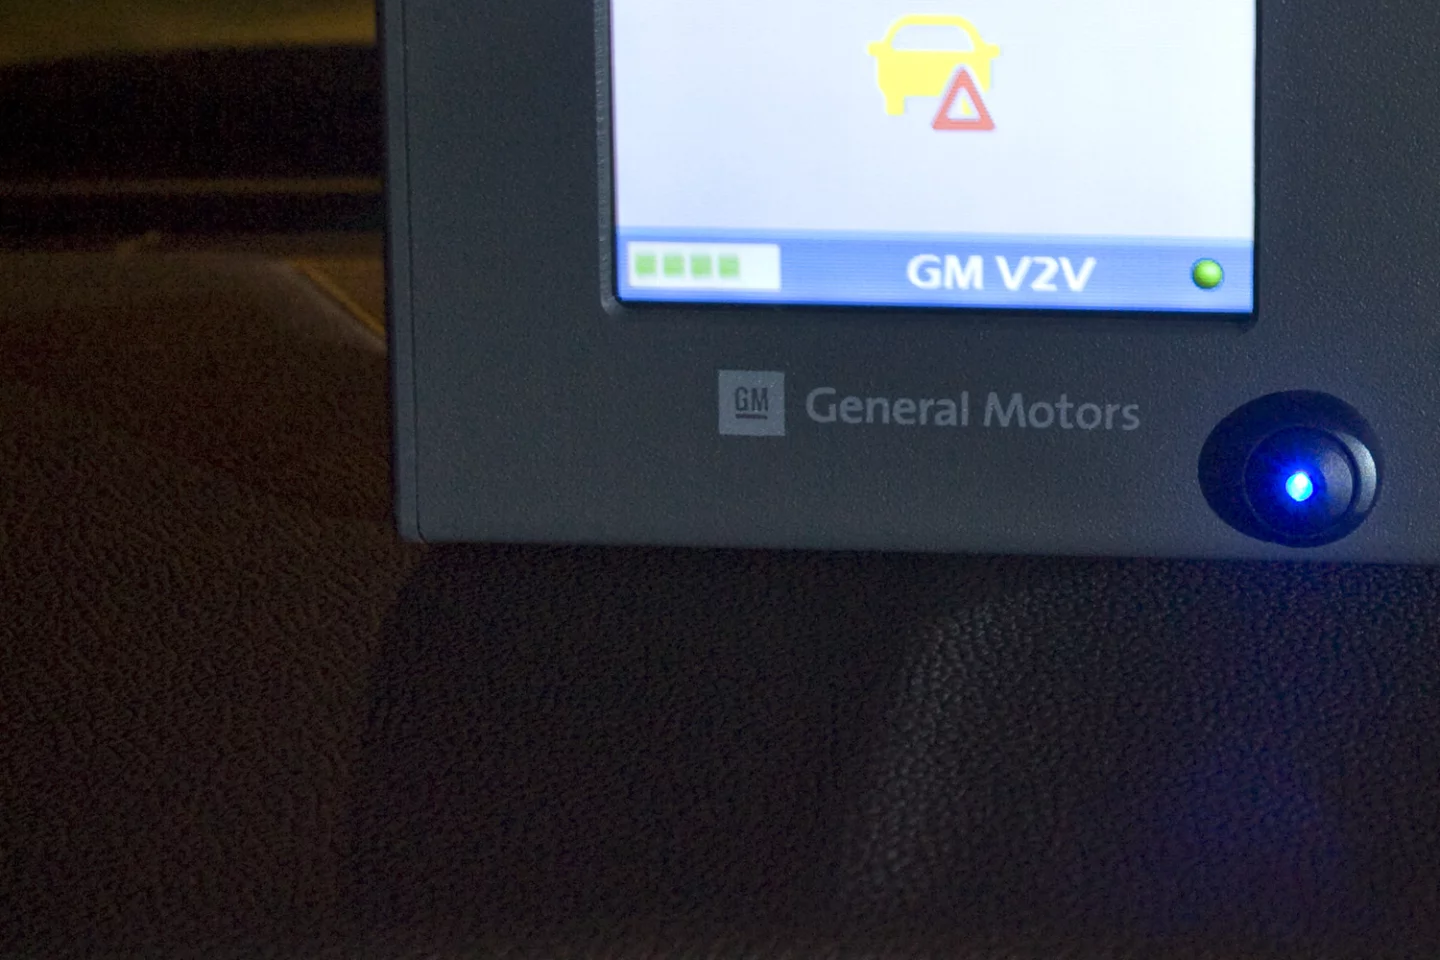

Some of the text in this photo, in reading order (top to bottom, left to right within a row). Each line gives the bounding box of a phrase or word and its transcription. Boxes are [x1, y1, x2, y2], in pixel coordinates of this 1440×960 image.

[906, 253, 1098, 292] GM V2V
[735, 386, 769, 411] GM
[805, 386, 1141, 432] General Motors
